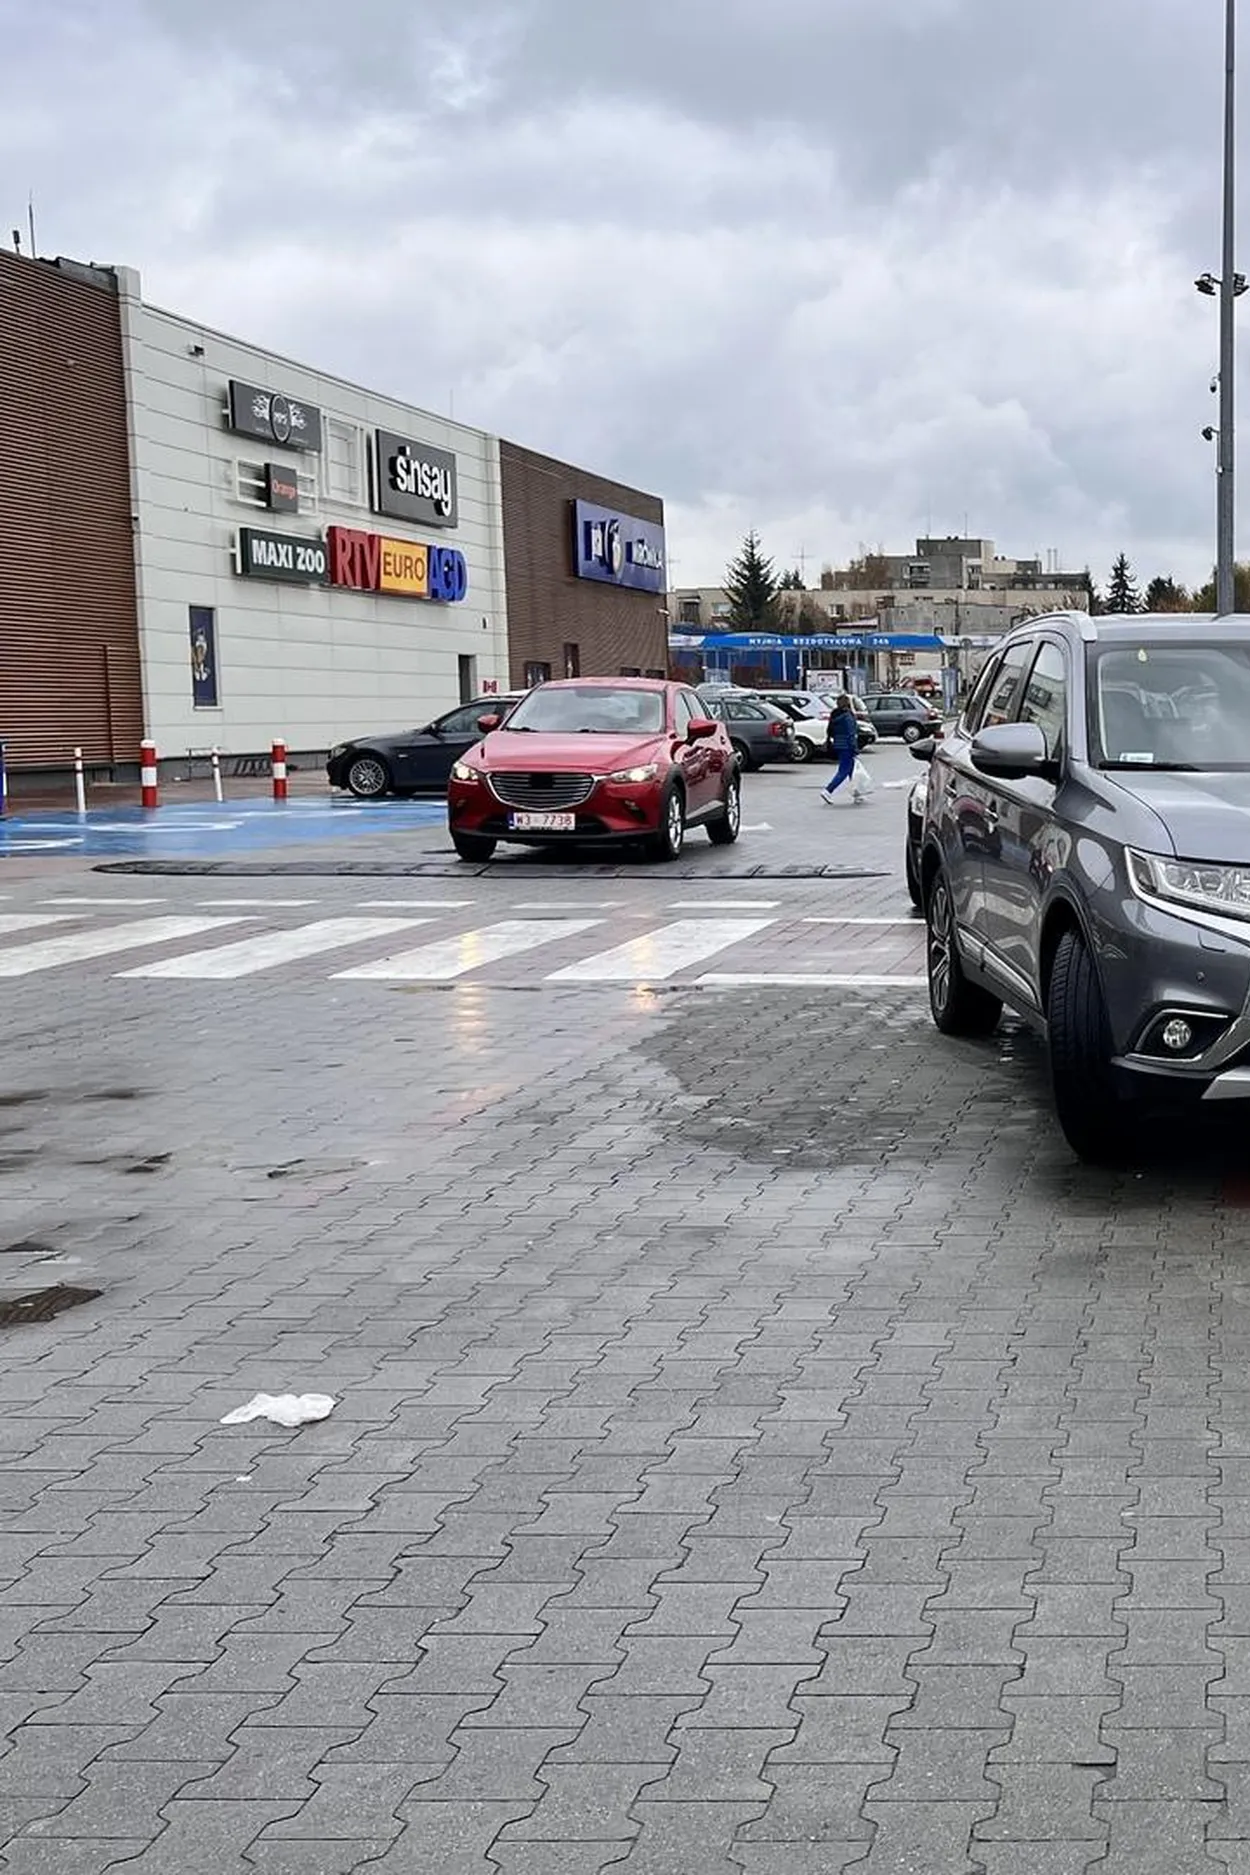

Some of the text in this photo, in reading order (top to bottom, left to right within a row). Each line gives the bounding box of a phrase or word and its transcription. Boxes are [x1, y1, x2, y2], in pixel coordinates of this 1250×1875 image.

[251, 539, 325, 574] MAXI ZOO
[334, 530, 467, 601] RTV EURO AGD
